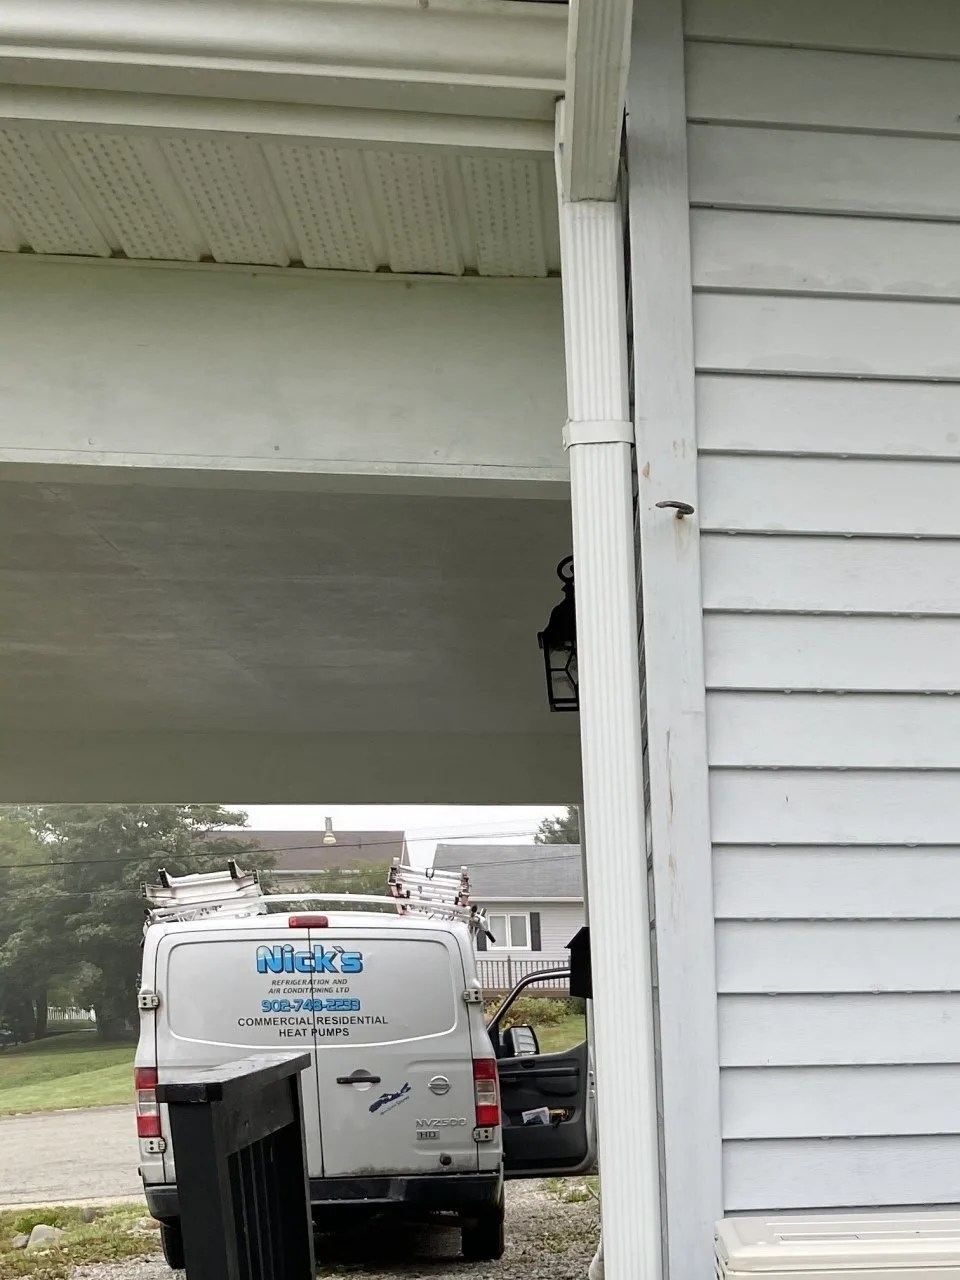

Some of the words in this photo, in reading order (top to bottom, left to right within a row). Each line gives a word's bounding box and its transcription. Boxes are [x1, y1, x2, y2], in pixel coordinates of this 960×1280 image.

[256, 944, 363, 973] Nick's
[237, 1017, 313, 1027] COMMERCIAL
[316, 1016, 389, 1025] RESIDENTIAL
[279, 1028, 307, 1037] HEAT
[311, 1028, 350, 1037] PUMPS
